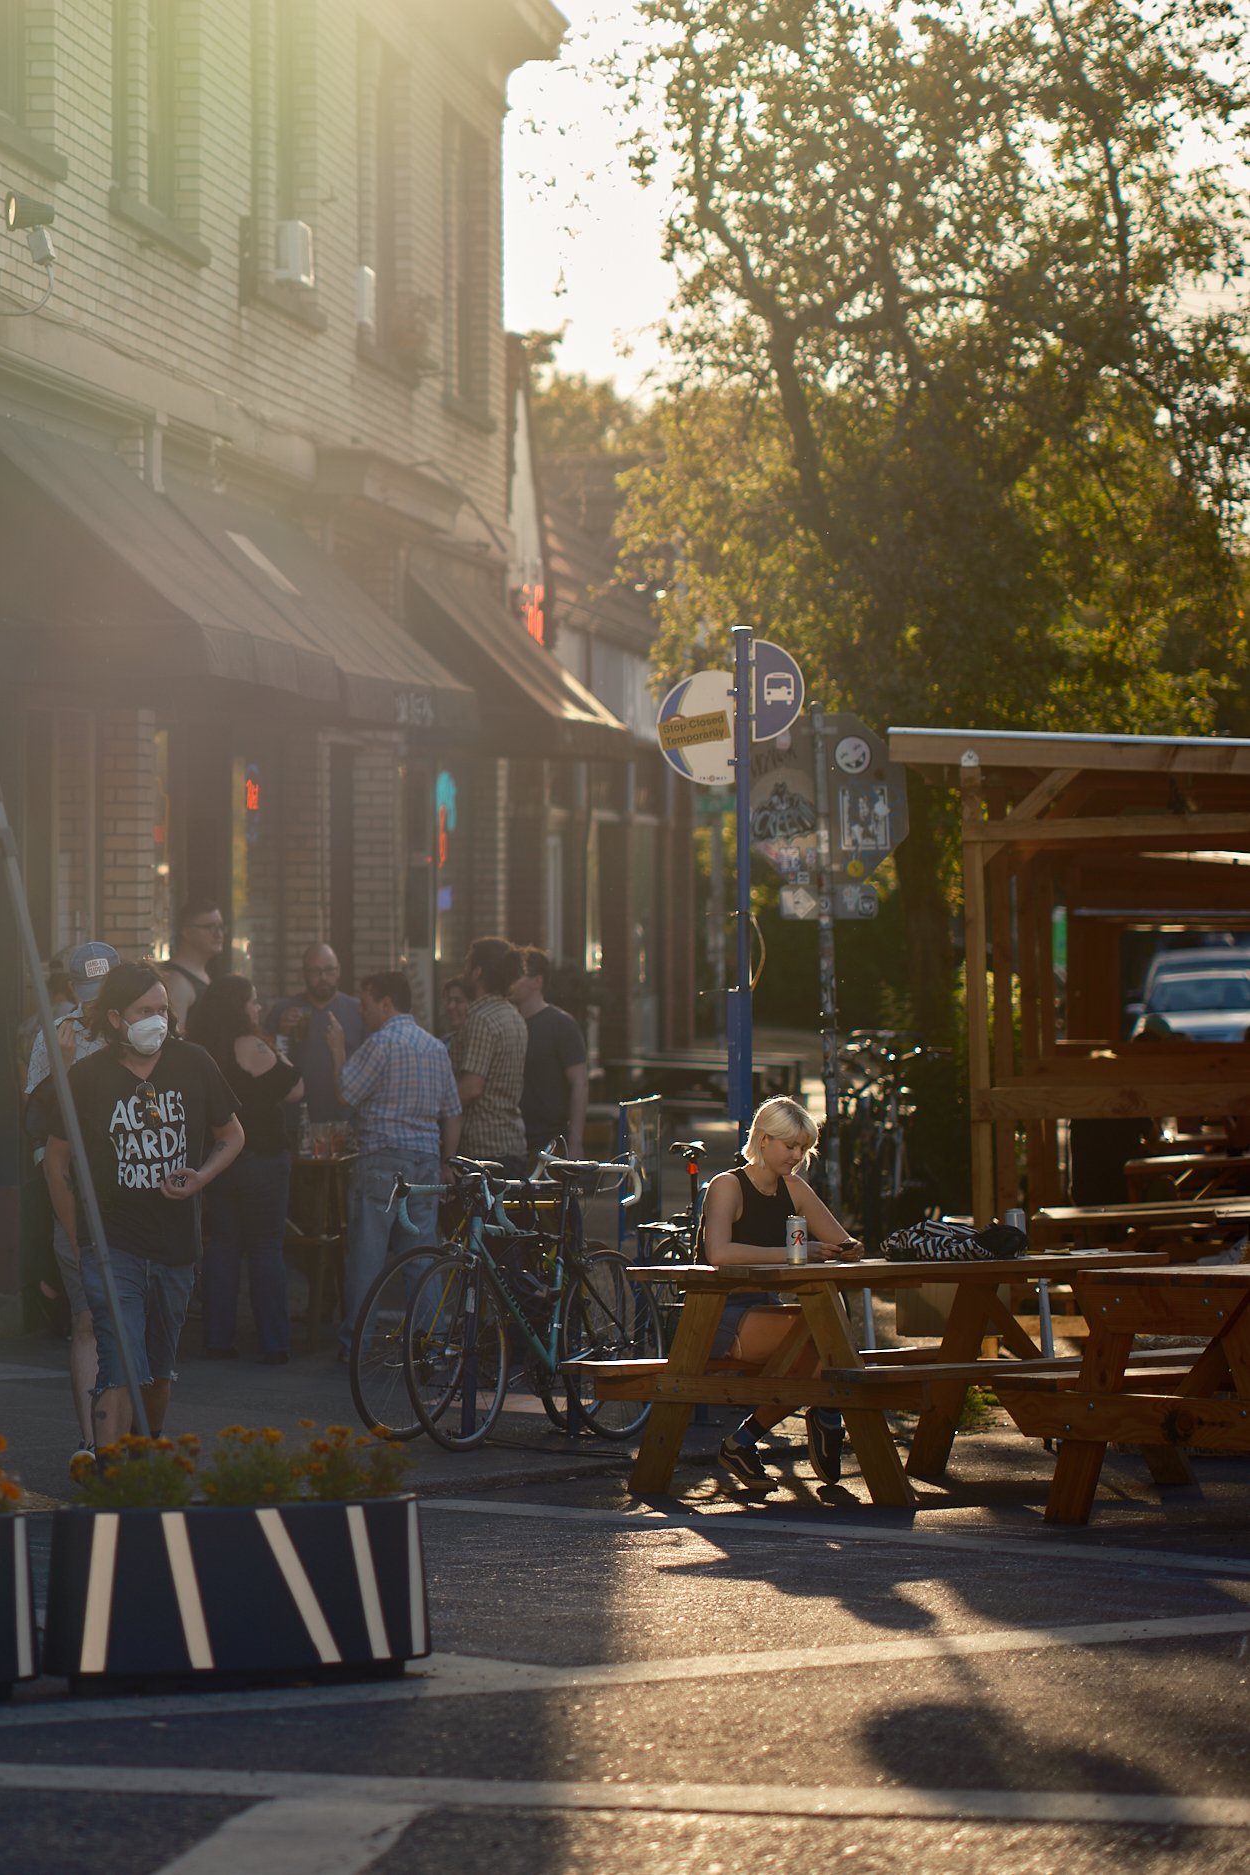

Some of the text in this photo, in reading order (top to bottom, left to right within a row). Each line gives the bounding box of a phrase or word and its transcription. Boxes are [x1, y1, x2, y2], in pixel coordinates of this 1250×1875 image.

[663, 714, 725, 734] Stop Closed
[665, 728, 726, 746] Temporarily
[109, 1124, 187, 1161] VARDA
[117, 1151, 187, 1190] FOREVE
